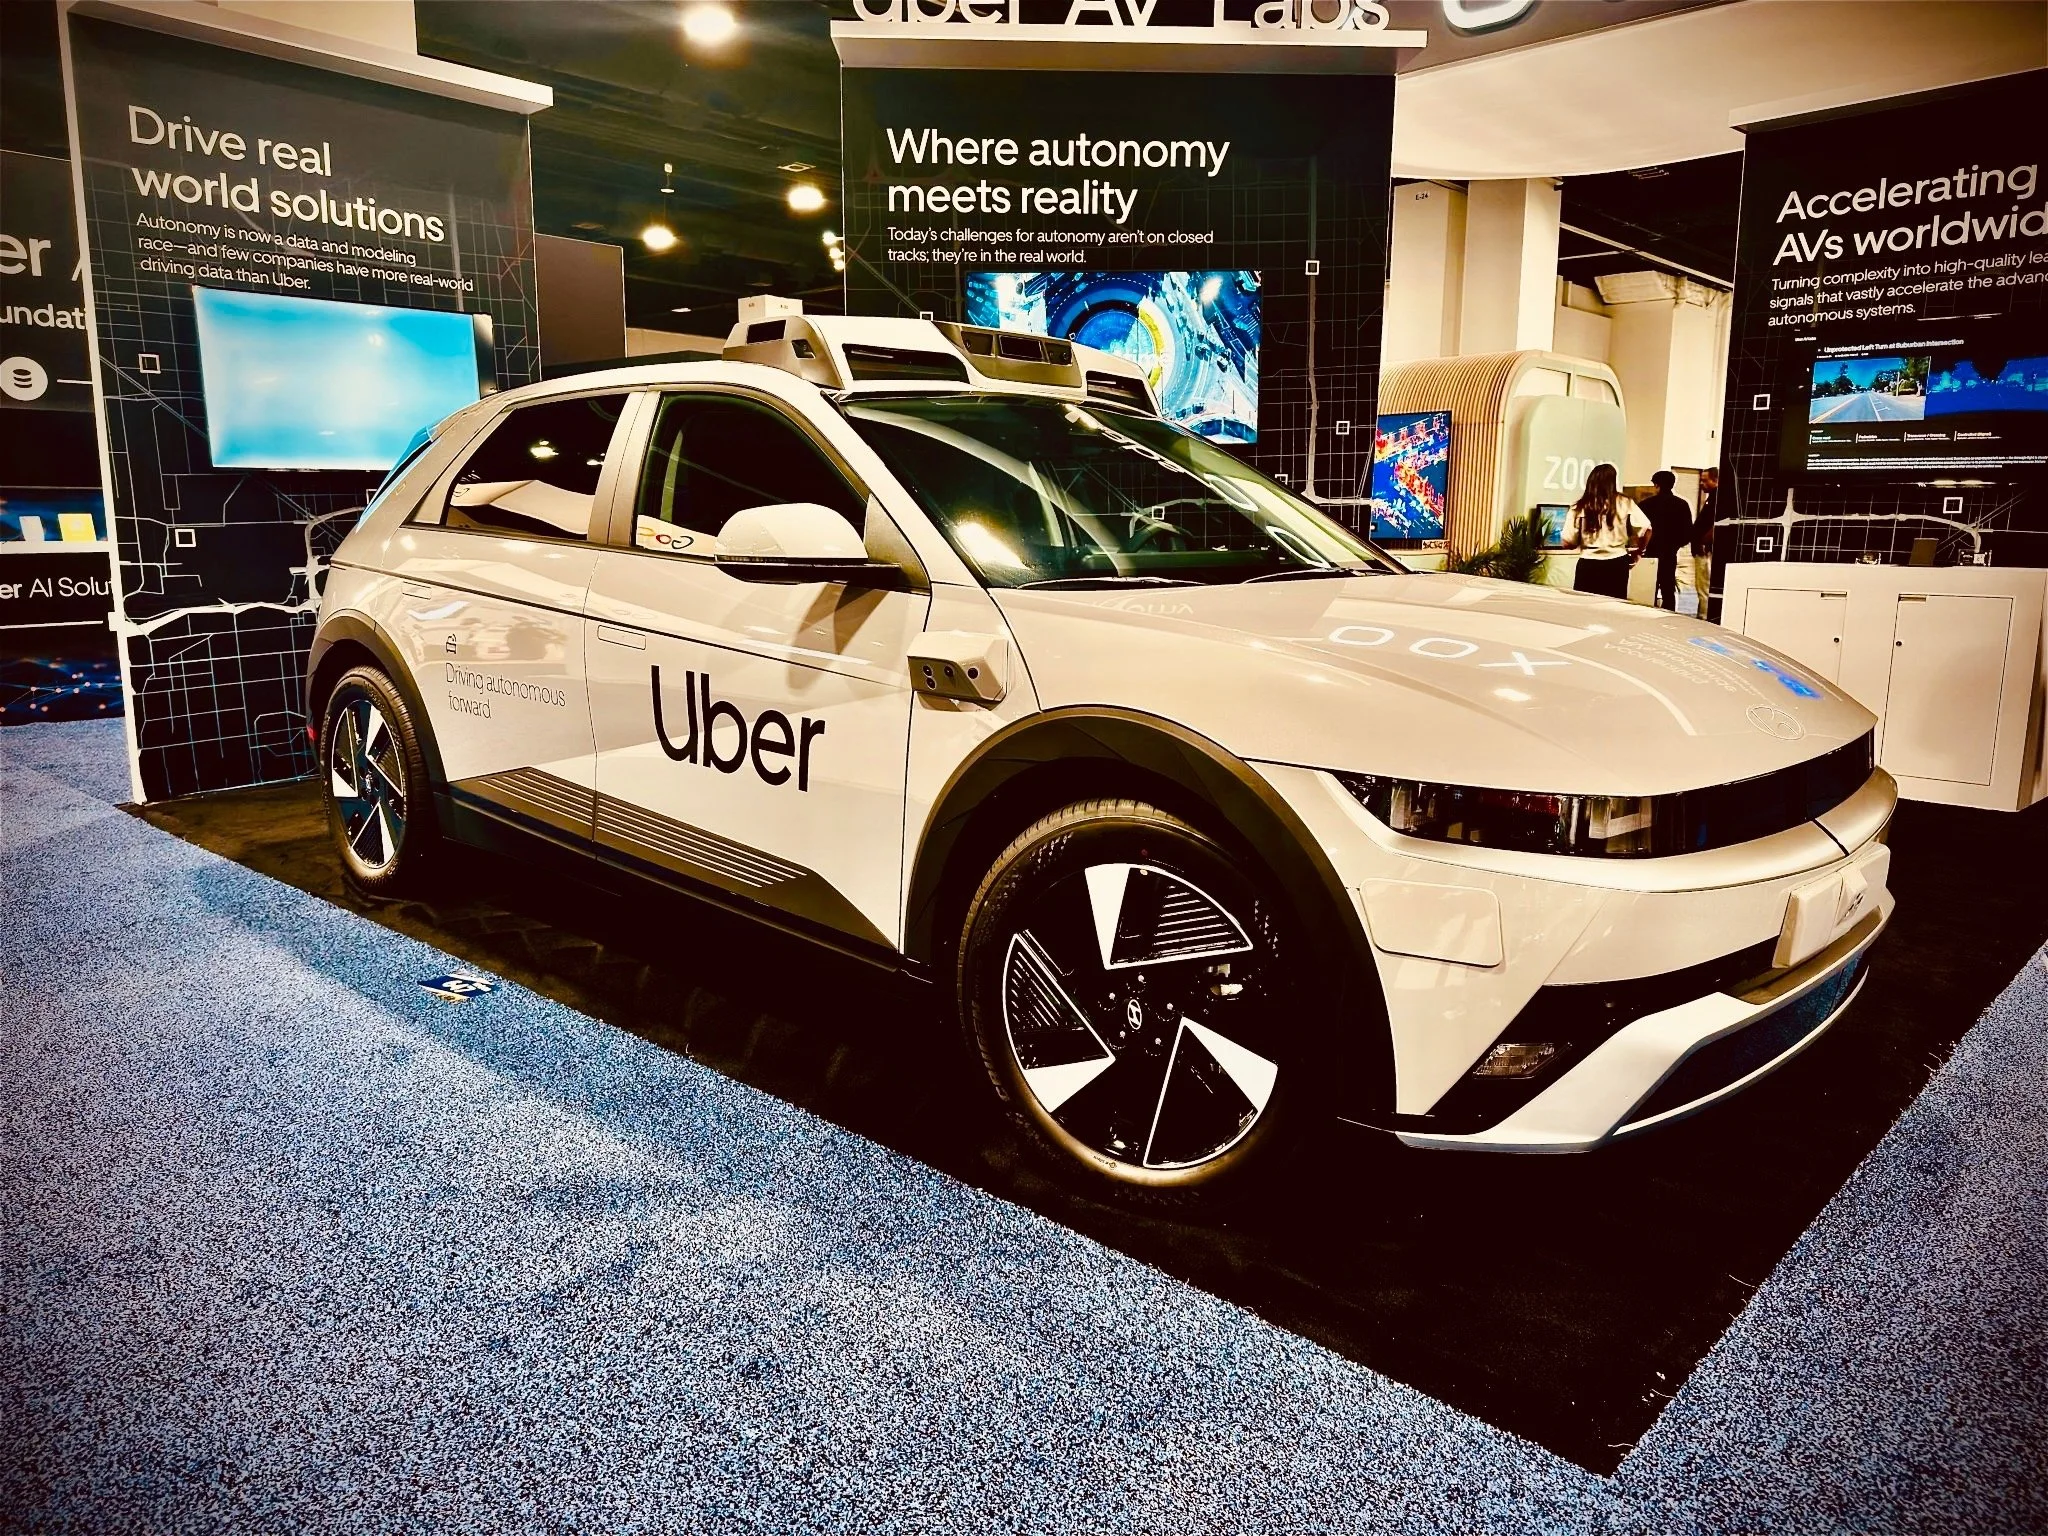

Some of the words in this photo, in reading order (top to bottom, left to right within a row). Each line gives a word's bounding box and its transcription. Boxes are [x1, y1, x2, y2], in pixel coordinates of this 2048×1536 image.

[128, 104, 247, 161] Drive
[257, 138, 332, 177] real
[886, 128, 1019, 166] Where
[1028, 132, 1231, 177] autonomy
[131, 167, 260, 213] world
[270, 188, 446, 242] solutions
[888, 179, 1011, 214] meets
[1021, 179, 1138, 225] reality
[1775, 163, 2038, 224] Accelerating
[136, 212, 221, 239] Autonomy
[224, 224, 236, 239] is
[239, 229, 272, 244] now
[274, 234, 284, 246] a
[287, 234, 320, 251] data
[321, 239, 349, 255] and
[351, 242, 417, 267] modeling
[887, 226, 938, 244] Today’s
[940, 227, 1013, 244] challenges
[1016, 228, 1035, 242] for
[1037, 229, 1106, 246] autonomy
[1108, 230, 1144, 244] aren’t
[1147, 232, 1165, 244] on
[1168, 230, 1214, 244] closed
[888, 248, 930, 263] tracks;
[932, 248, 978, 264] they’re
[980, 248, 992, 262] in
[994, 249, 1017, 262] the
[1019, 249, 1044, 263] real
[1046, 249, 1087, 263] world.
[1772, 230, 1844, 266] AVs
[138, 236, 218, 258] race—and
[222, 244, 250, 262] few
[252, 251, 335, 273] companies
[336, 260, 370, 278] have
[371, 268, 408, 283] more
[409, 272, 474, 292] real-world
[140, 257, 195, 279] driving
[198, 263, 234, 281] data
[236, 268, 270, 285] than
[272, 273, 311, 290] Uber.
[1771, 276, 1821, 291] Turning
[1822, 265, 1901, 286] complexity
[1903, 263, 1931, 278] into
[1933, 250, 2027, 274] high-quality
[1768, 309, 1854, 327] autonomous
[1855, 302, 1917, 319] systems.
[1769, 292, 1814, 311] signals
[1816, 290, 1844, 304] that
[1845, 284, 1885, 302] vastly
[1887, 278, 1964, 297] accelerate
[1968, 275, 1993, 289] the
[29, 577, 53, 598] AI
[58, 576, 112, 597] Solu
[445, 662, 484, 694] Driving
[486, 674, 566, 707] autonomous
[448, 690, 491, 719] forward
[650, 664, 826, 793] Uber
